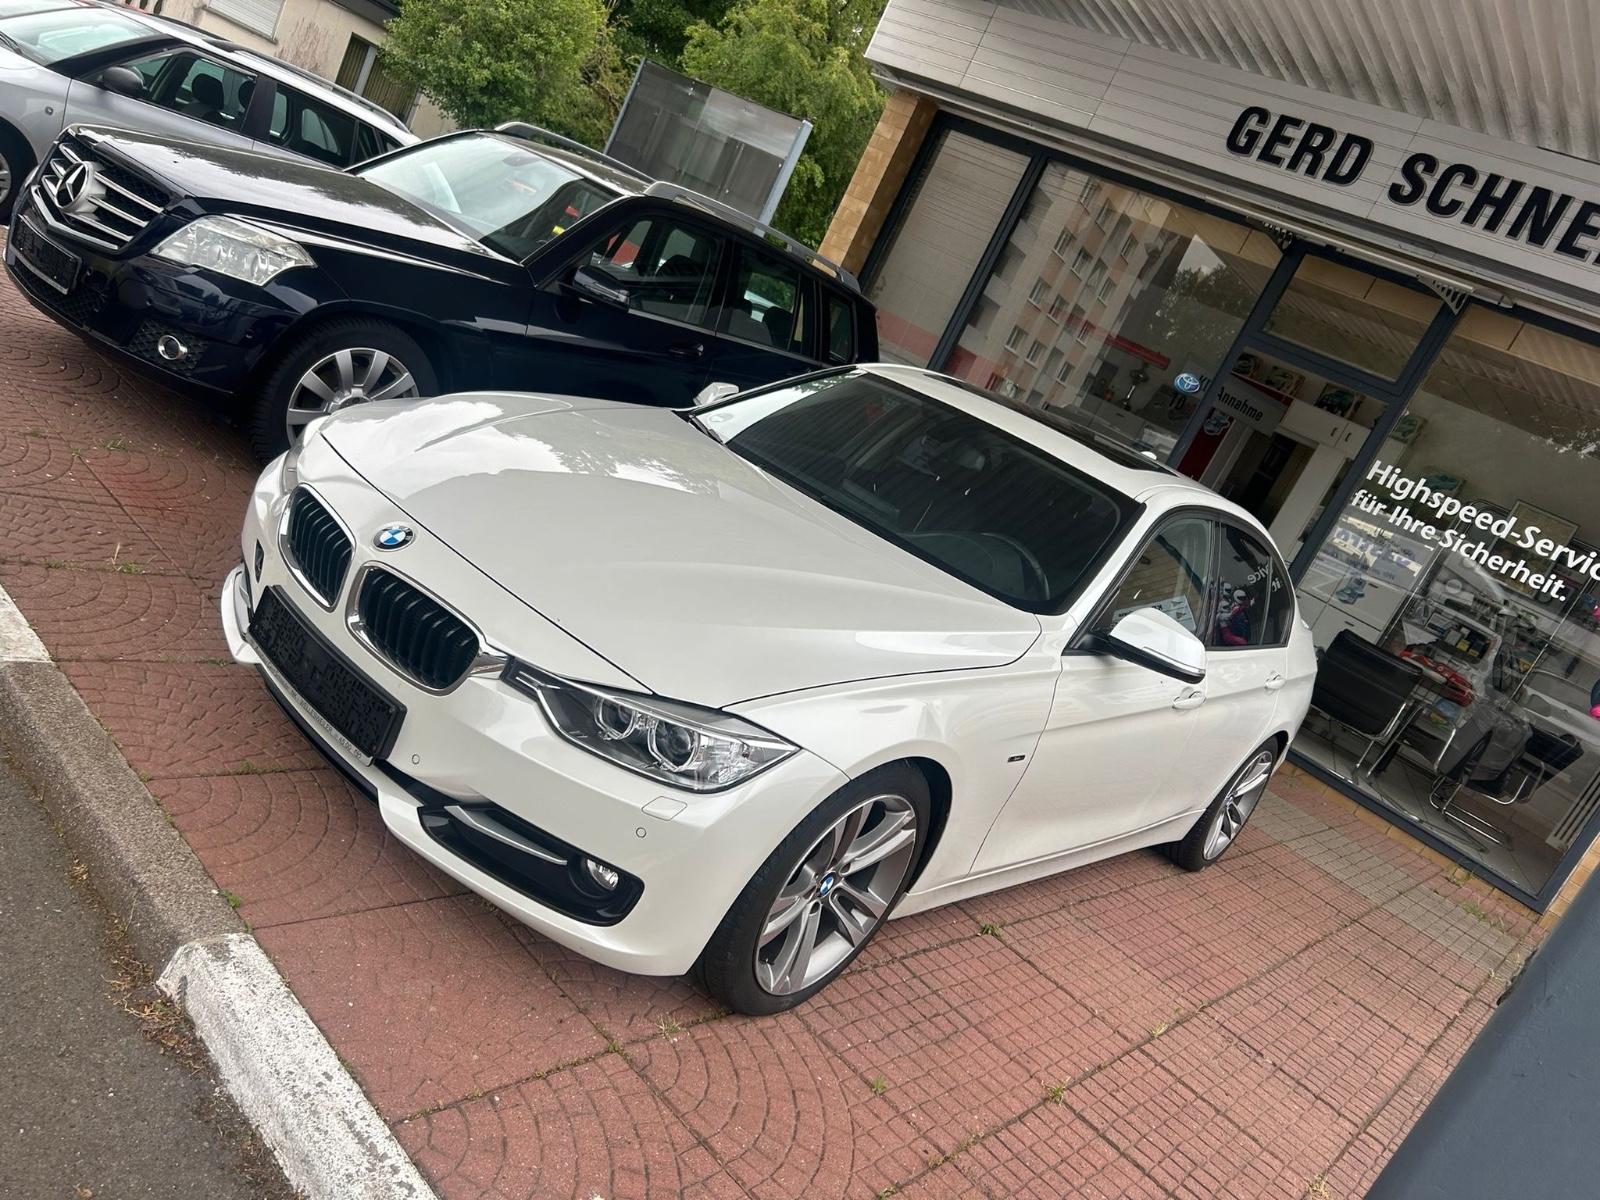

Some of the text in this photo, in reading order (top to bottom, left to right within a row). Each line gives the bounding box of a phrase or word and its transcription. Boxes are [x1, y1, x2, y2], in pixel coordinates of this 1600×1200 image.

[1226, 105, 1600, 266] GERD SCHNE
[1351, 489, 1387, 516] für
[1388, 506, 1436, 540] Ihre
[1438, 529, 1566, 602] Sicherheit.
